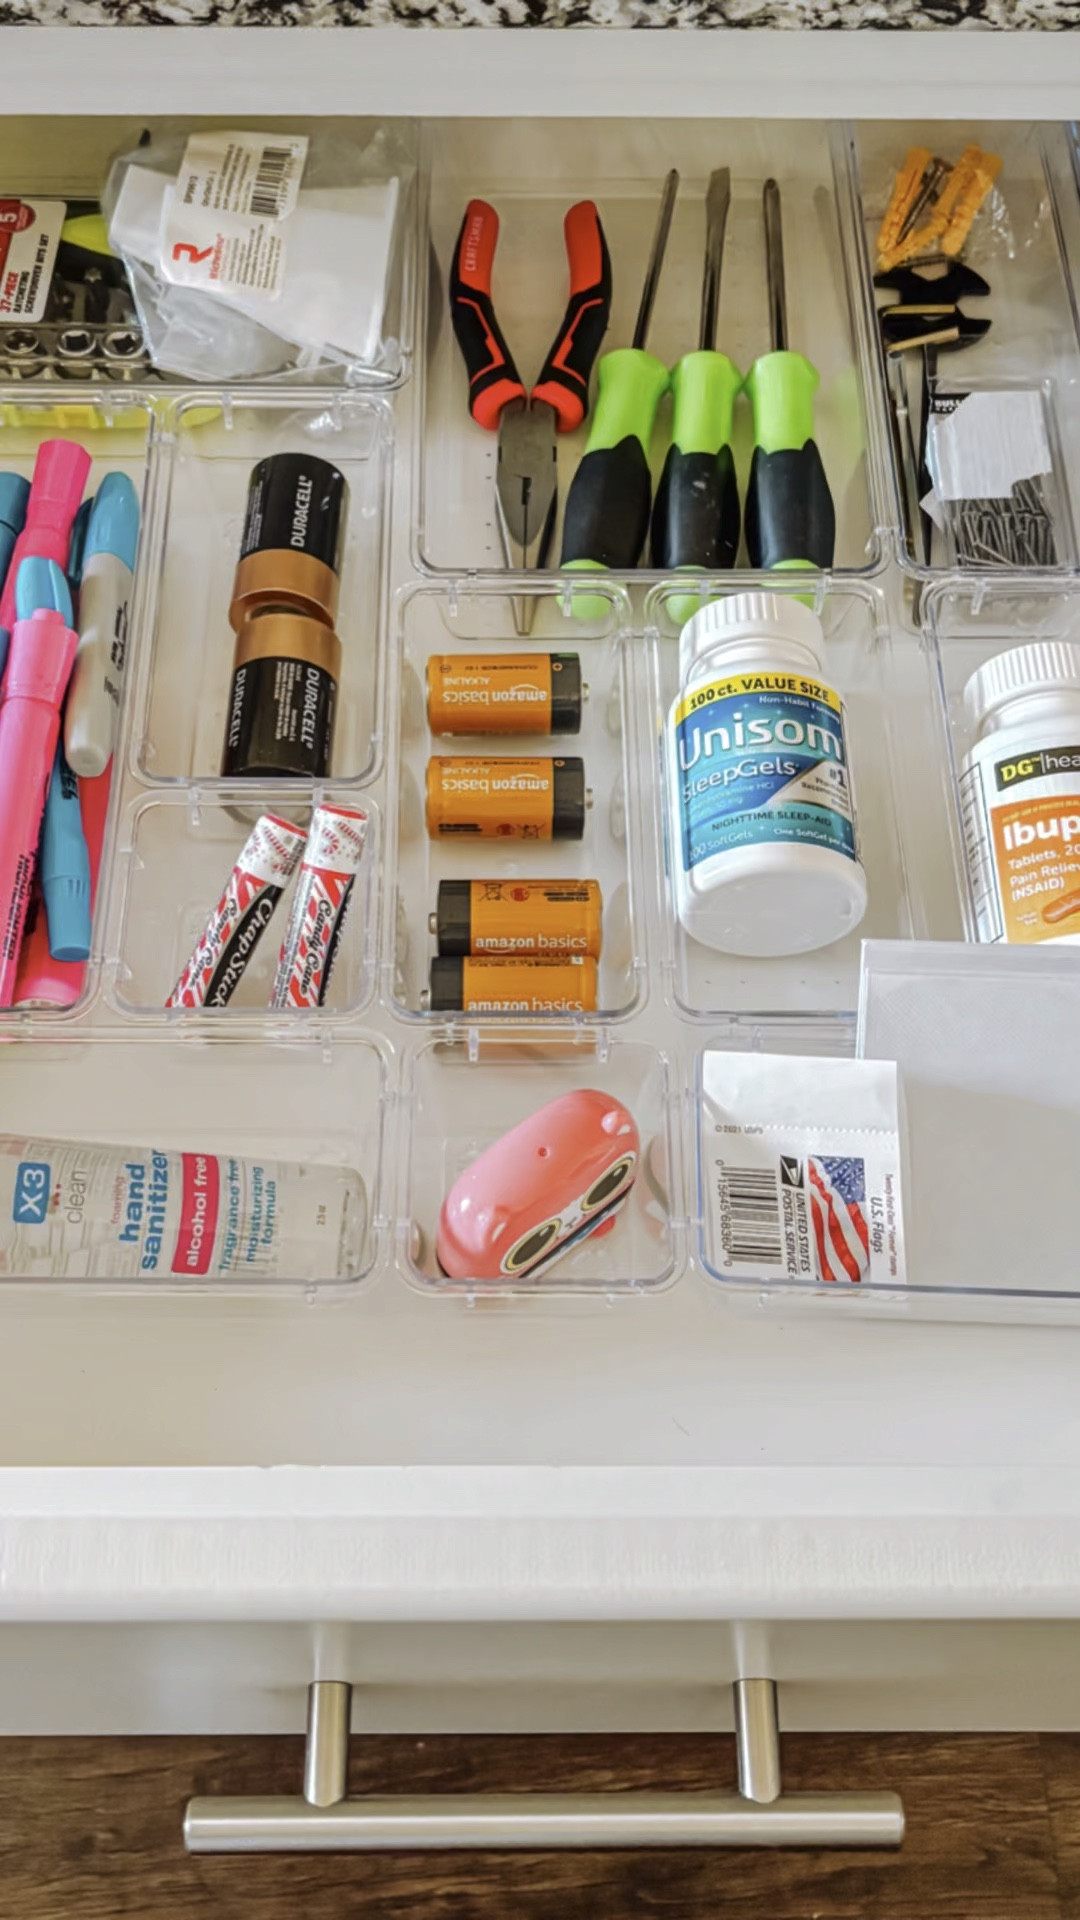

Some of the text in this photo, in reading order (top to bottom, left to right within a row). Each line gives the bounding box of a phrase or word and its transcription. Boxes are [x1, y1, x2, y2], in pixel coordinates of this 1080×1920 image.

[465, 216, 483, 271] CRAFTSMAN
[13, 271, 29, 313] RATCHETING
[24, 234, 48, 313] SCREWDRIVER BITS SET
[290, 480, 313, 547] DURACELL
[229, 669, 246, 744] DURACELL
[301, 668, 320, 742] DURACELL
[443, 689, 547, 705] amazon basics
[690, 678, 829, 709] 100 ct. VALUE SIZE
[678, 712, 842, 771] Unisom
[442, 779, 549, 793] amazon basics
[683, 757, 798, 803] SleepGels
[1001, 759, 1034, 782] DG
[712, 811, 832, 831] NIGHTTIME SLEEP-AID
[1010, 871, 1038, 887] Pain
[1012, 877, 1065, 902] (NSAID)
[210, 899, 274, 1007] ChapStick
[300, 900, 332, 995] Candy Cane
[475, 934, 587, 949] amazon basics
[468, 998, 582, 1011] amazon basics
[19, 1169, 45, 1216] X3
[64, 1171, 87, 1224] clean
[111, 1176, 125, 1224] foaming
[119, 1164, 144, 1242] hand
[141, 1150, 168, 1271] sanitizer
[186, 1157, 207, 1267] alcohol free
[218, 1159, 240, 1271] fragrance free
[246, 1166, 264, 1262] moisturizing
[262, 1181, 276, 1245] formula
[782, 1189, 797, 1274] POSTAL SERVICE
[796, 1193, 810, 1272] UNITED STATES
[871, 1197, 884, 1254] U.S. Flags
